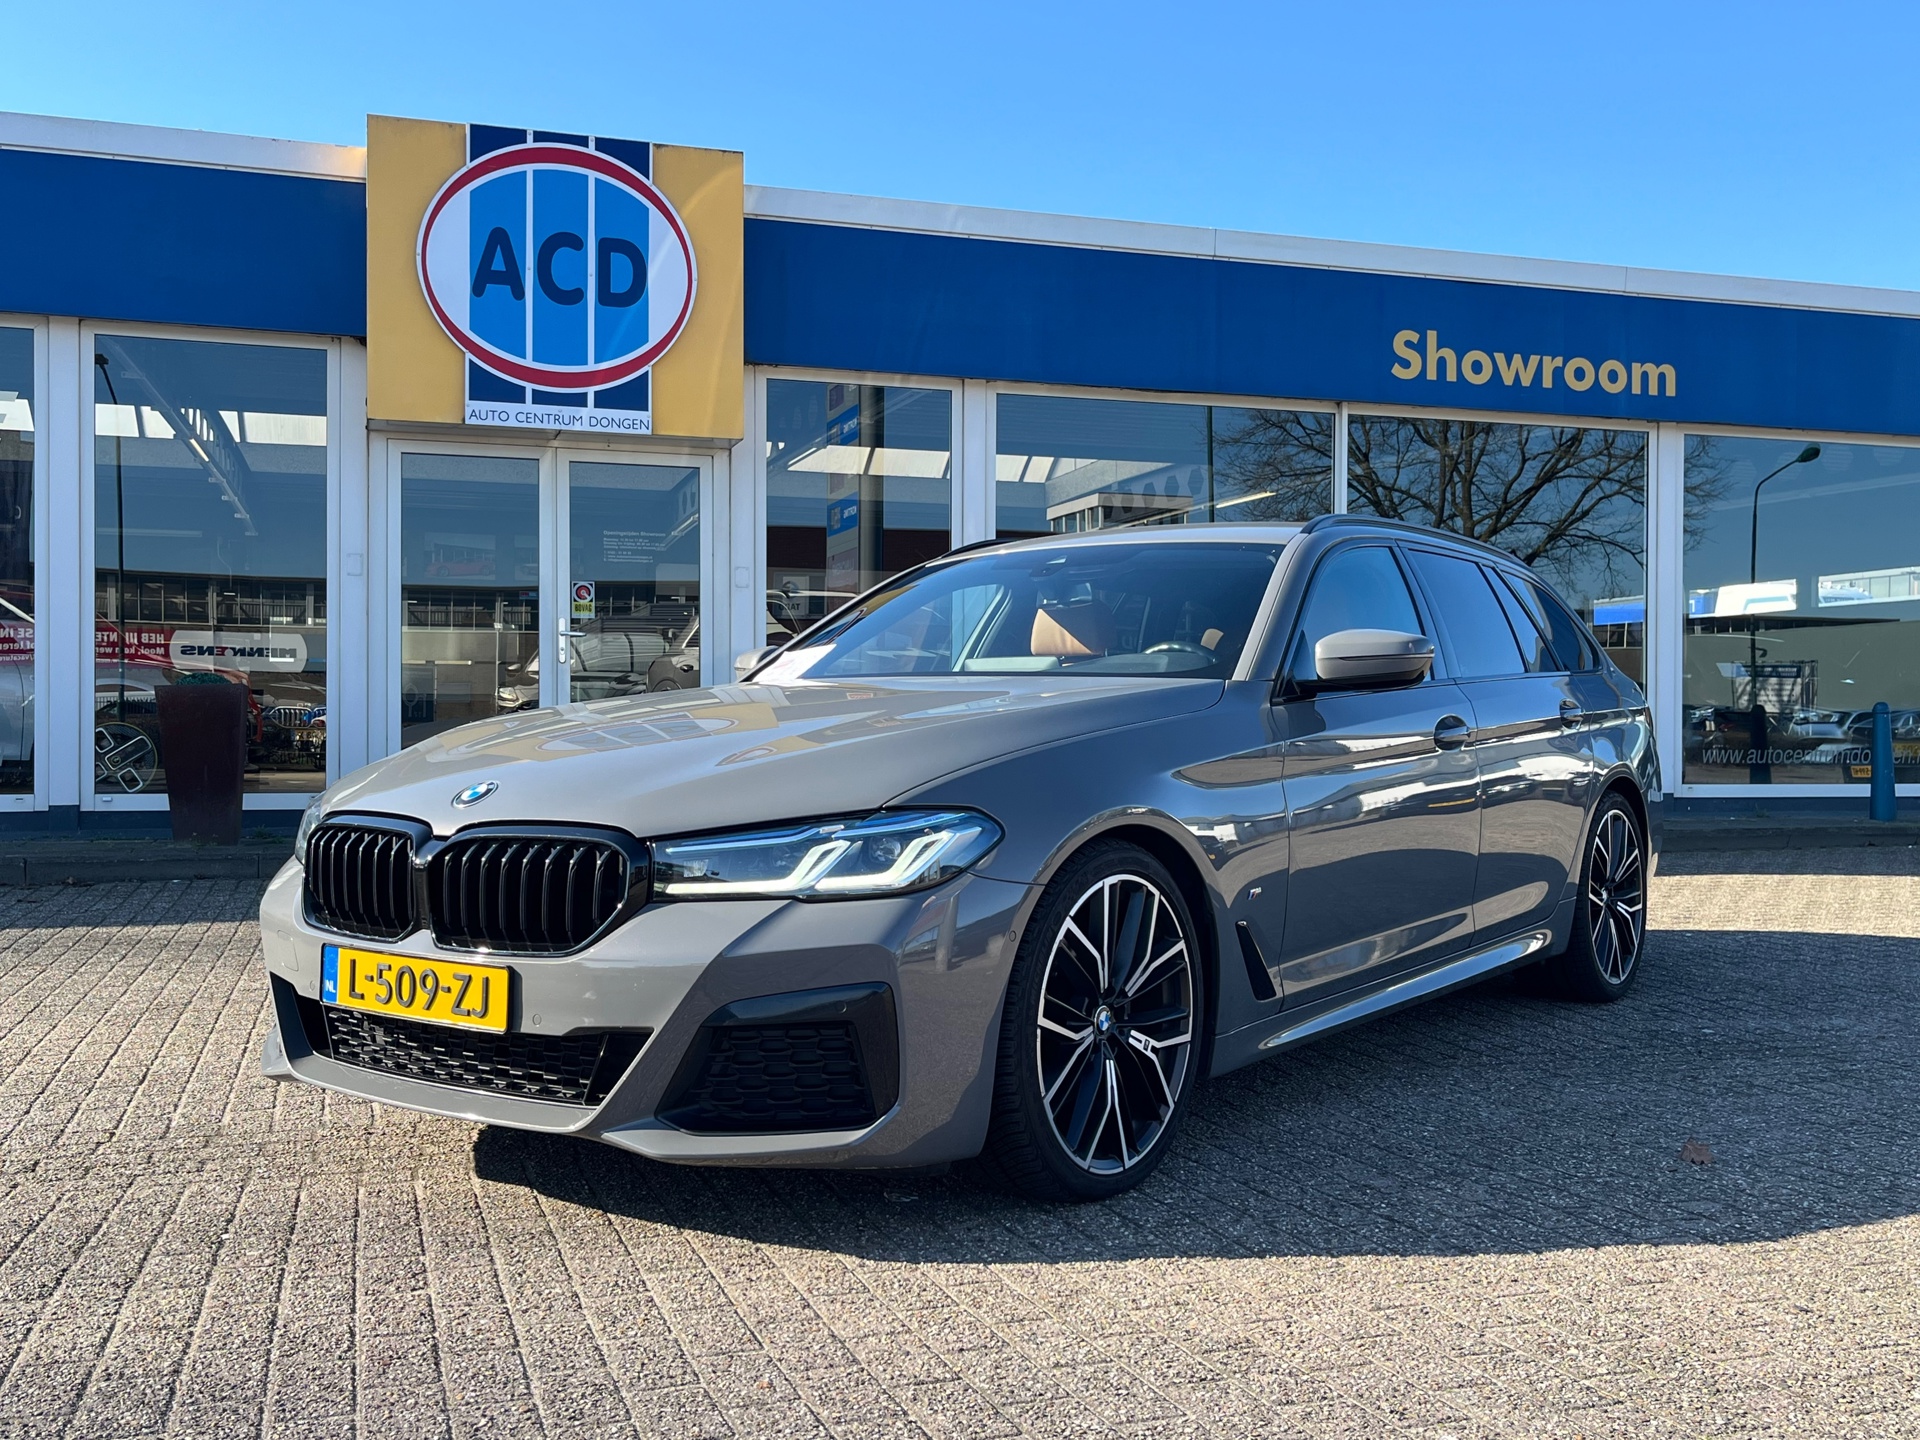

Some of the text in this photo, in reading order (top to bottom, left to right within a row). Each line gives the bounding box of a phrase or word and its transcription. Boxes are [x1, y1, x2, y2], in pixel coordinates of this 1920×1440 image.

[471, 226, 647, 308] ACD
[1390, 329, 1677, 398] Showroom
[468, 408, 650, 431] AUTO CENTRUM DONGEN
[325, 979, 337, 993] NL
[349, 957, 489, 1018] L-509-ZJ
